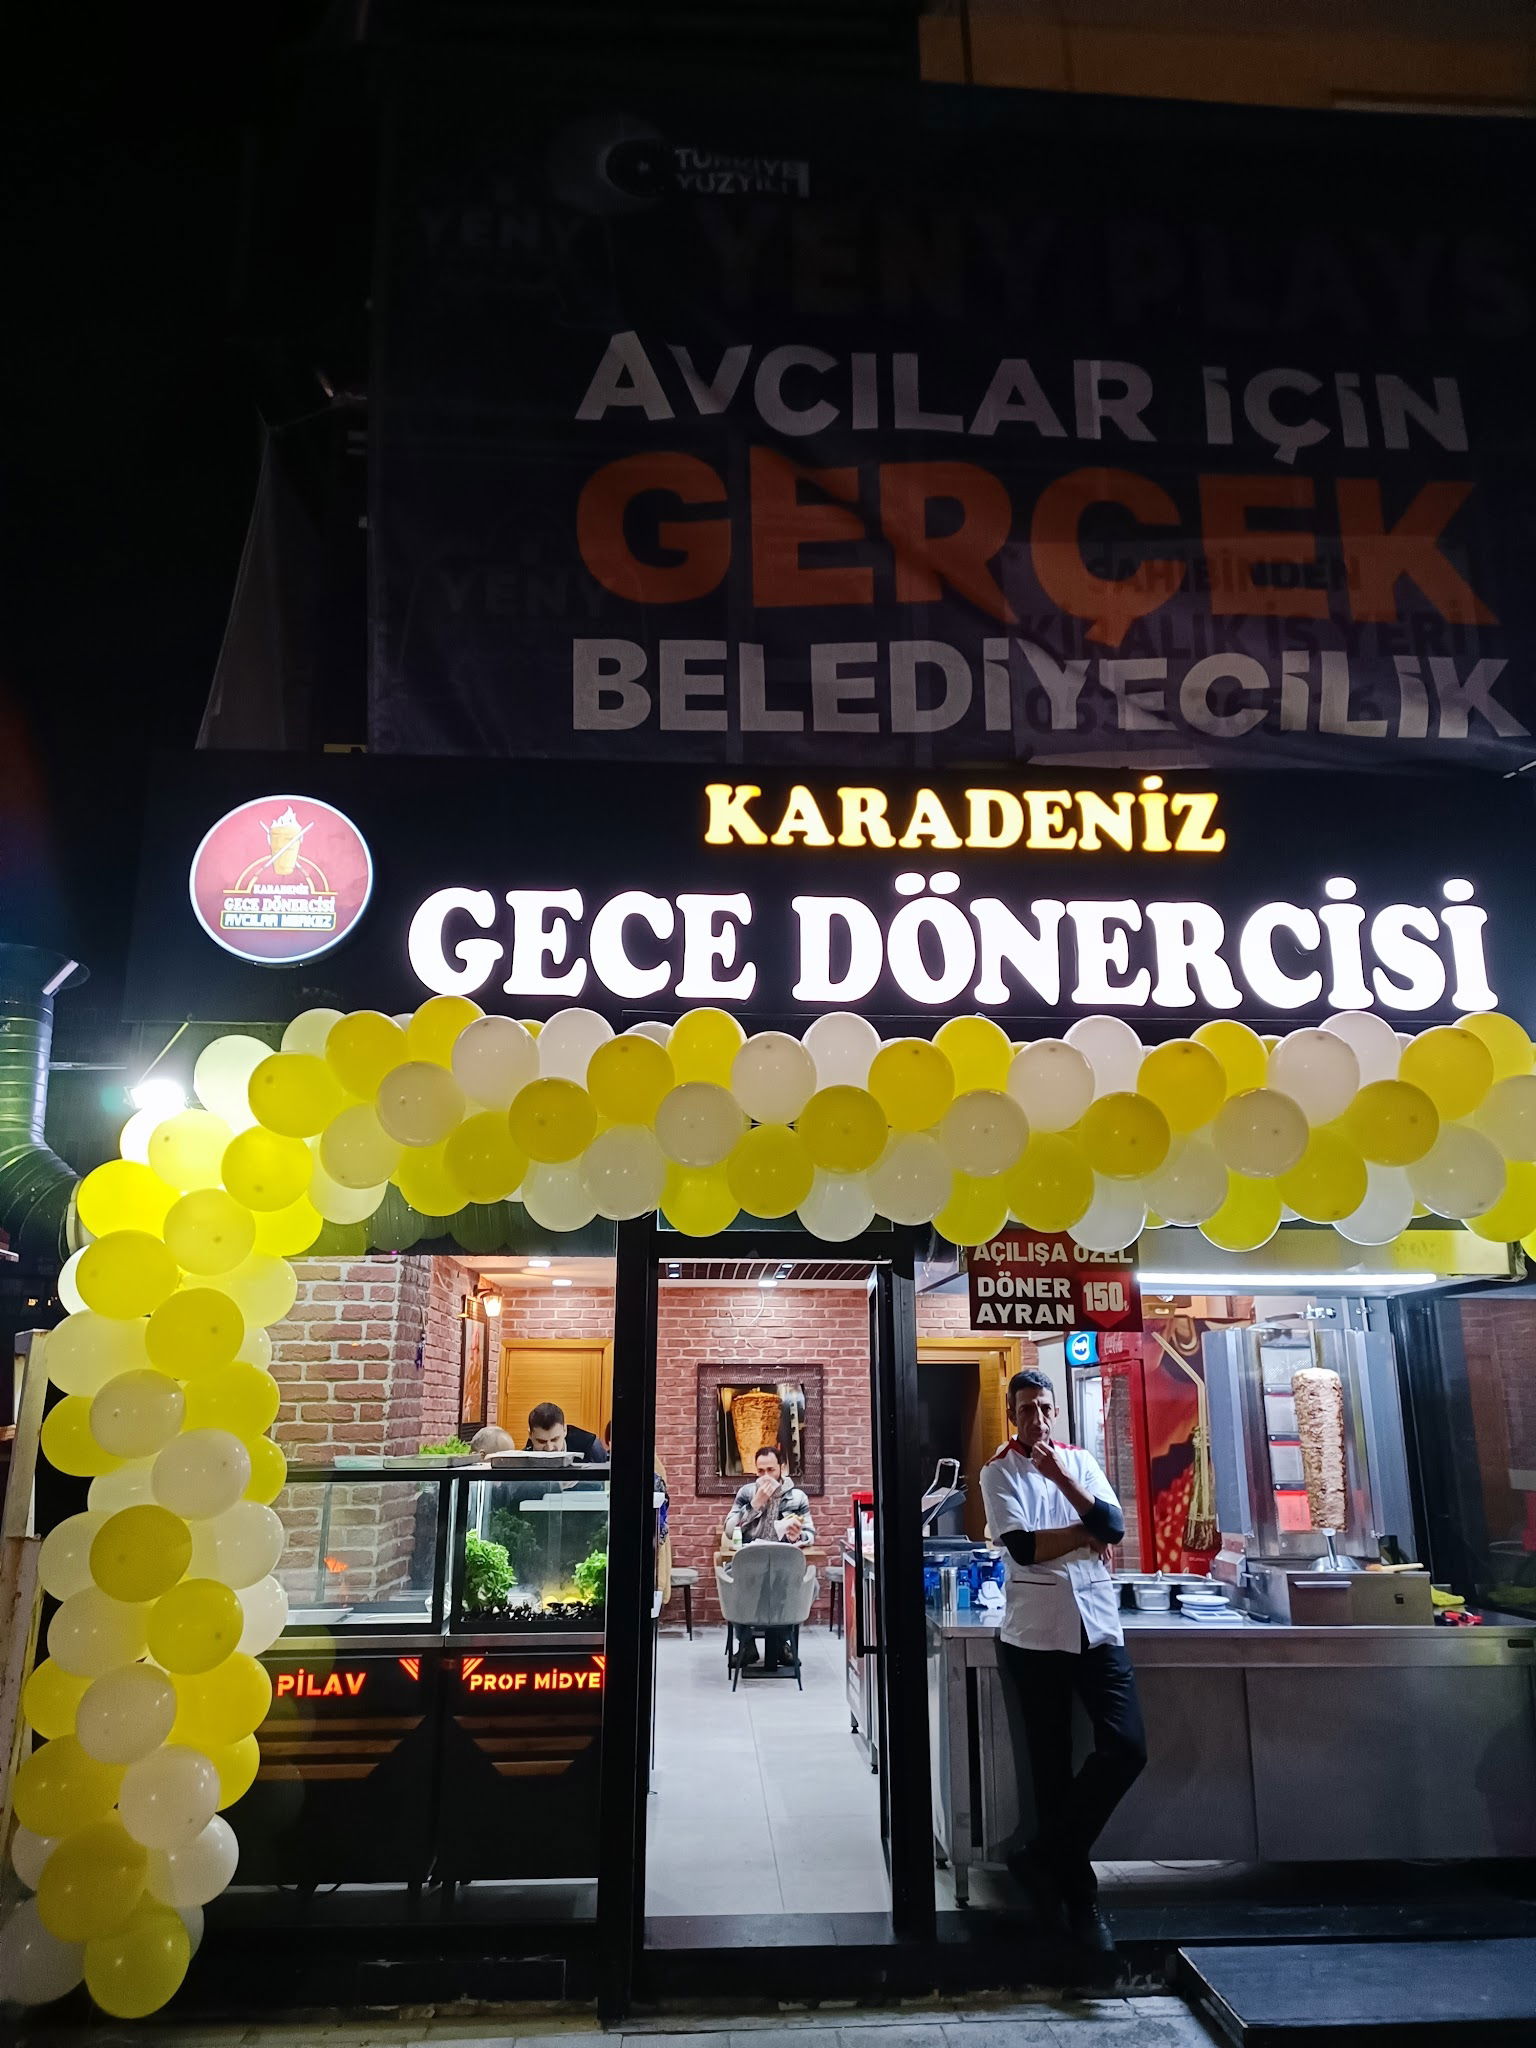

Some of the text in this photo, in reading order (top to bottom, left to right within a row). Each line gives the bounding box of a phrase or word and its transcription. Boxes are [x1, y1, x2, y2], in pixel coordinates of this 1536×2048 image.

[575, 331, 1469, 464] AVCILAR İÇİN
[576, 446, 1499, 646] GERÇEK
[572, 637, 1532, 738] BELEDİYECİLİK
[704, 776, 1226, 852] KARADENİZ
[408, 872, 1498, 1012] GECE DÖNERCİSİ
[973, 1241, 1068, 1266] AÇILIŞA
[977, 1270, 1071, 1298] DÖNER
[976, 1303, 1075, 1324] AYRAN
[276, 1668, 366, 1697] PİLAV
[470, 1667, 601, 1691] PROF MİDYE
